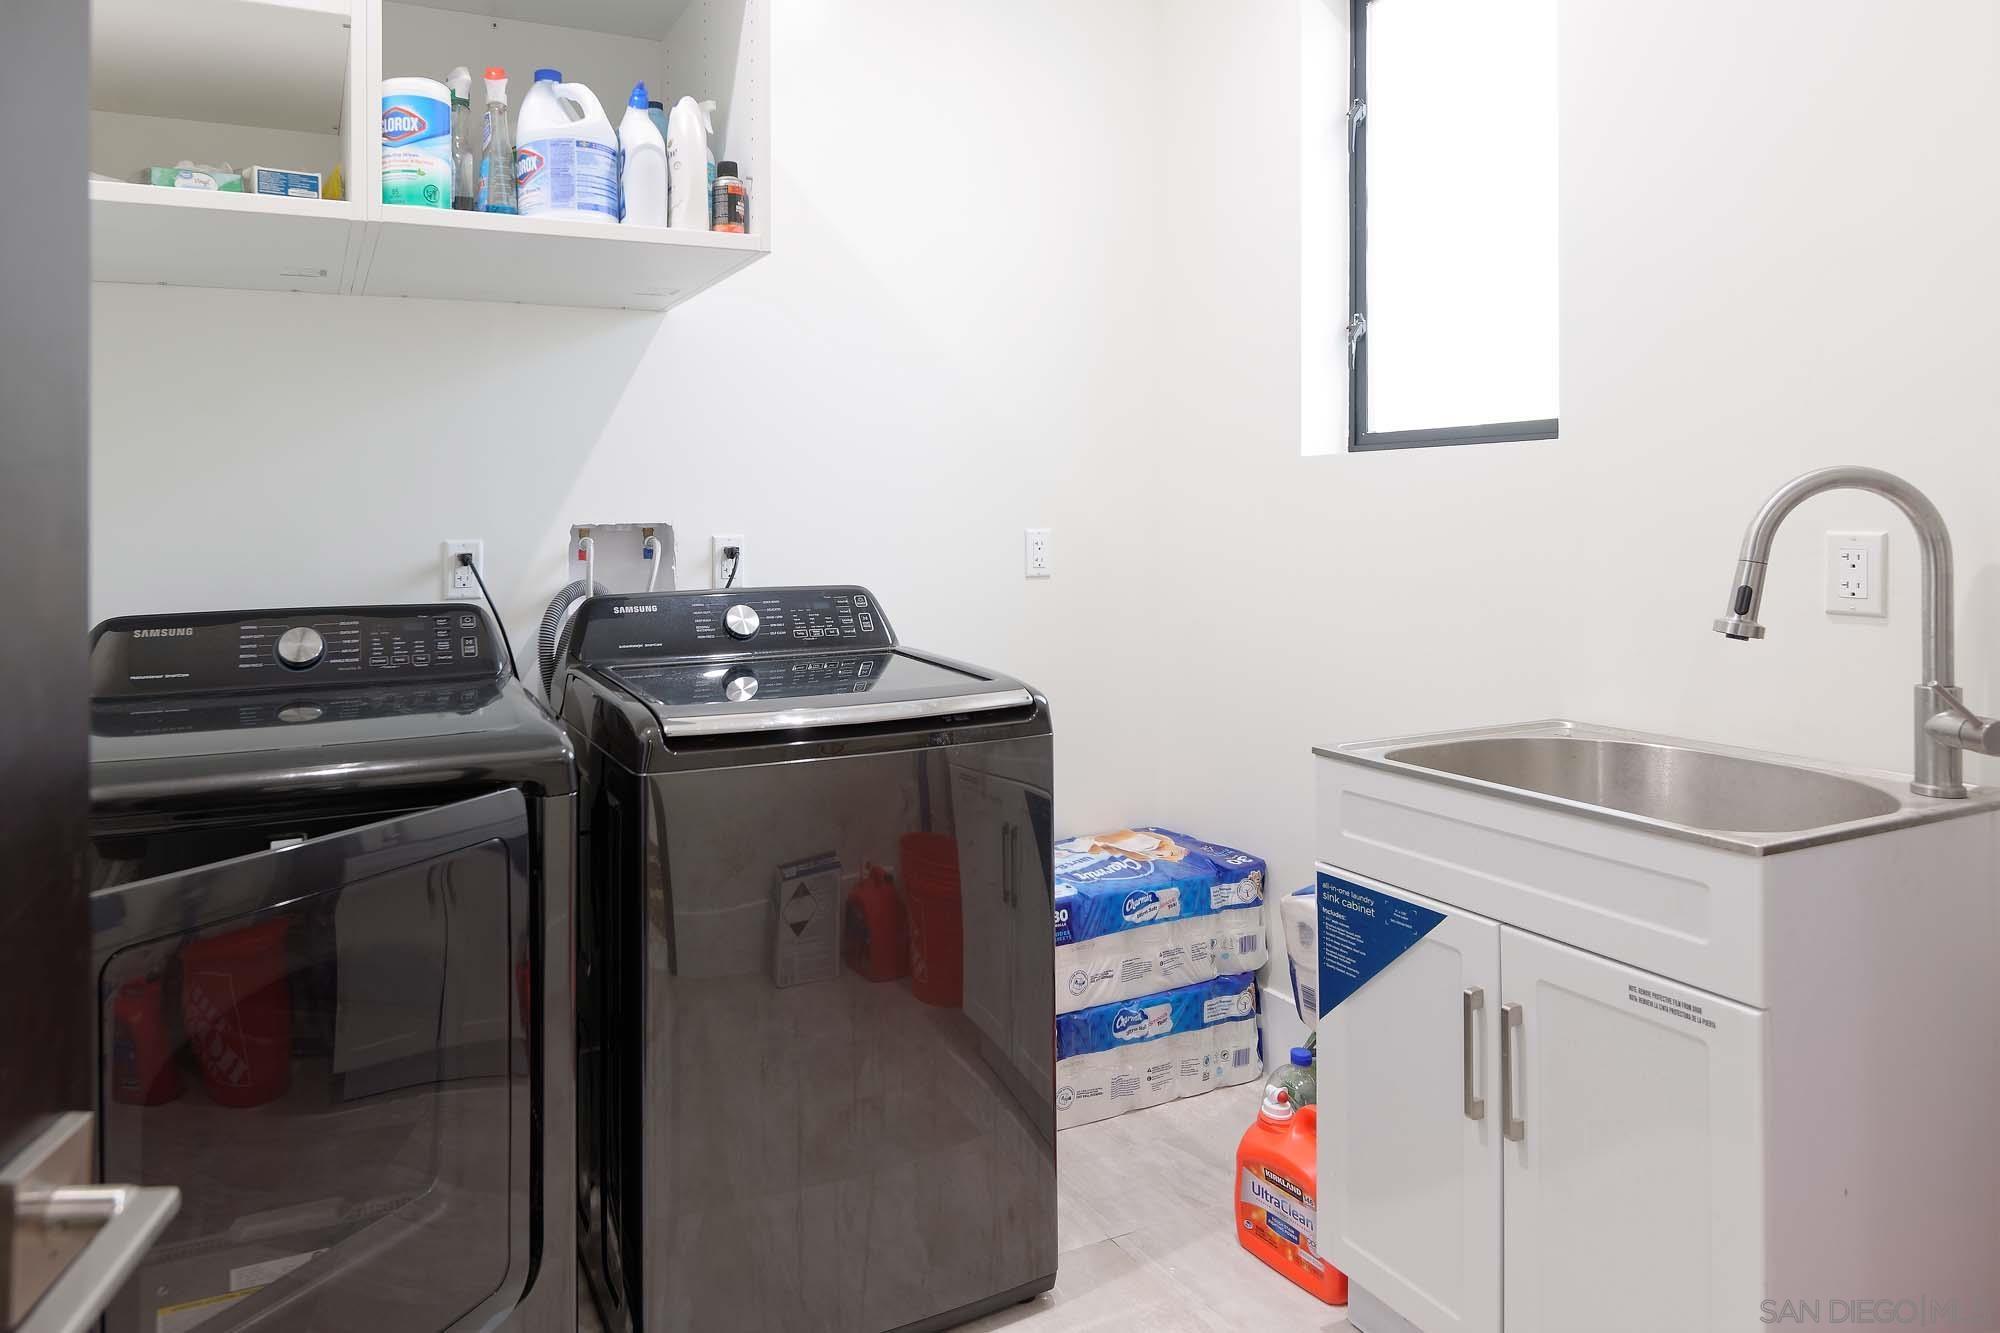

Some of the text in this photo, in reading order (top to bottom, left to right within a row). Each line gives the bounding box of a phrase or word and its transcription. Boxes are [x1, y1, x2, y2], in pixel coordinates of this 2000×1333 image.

[383, 117, 419, 132] LOROX
[614, 605, 658, 614] SAMSUNG
[133, 627, 193, 638] SAMSUNG
[1126, 893, 1153, 912] Charmin
[1322, 882, 1375, 906] all-in-one laundry
[1322, 891, 1376, 918] sink cabinet
[1265, 1169, 1302, 1196] KIRKLAND
[1251, 1181, 1314, 1231] UltraClean
